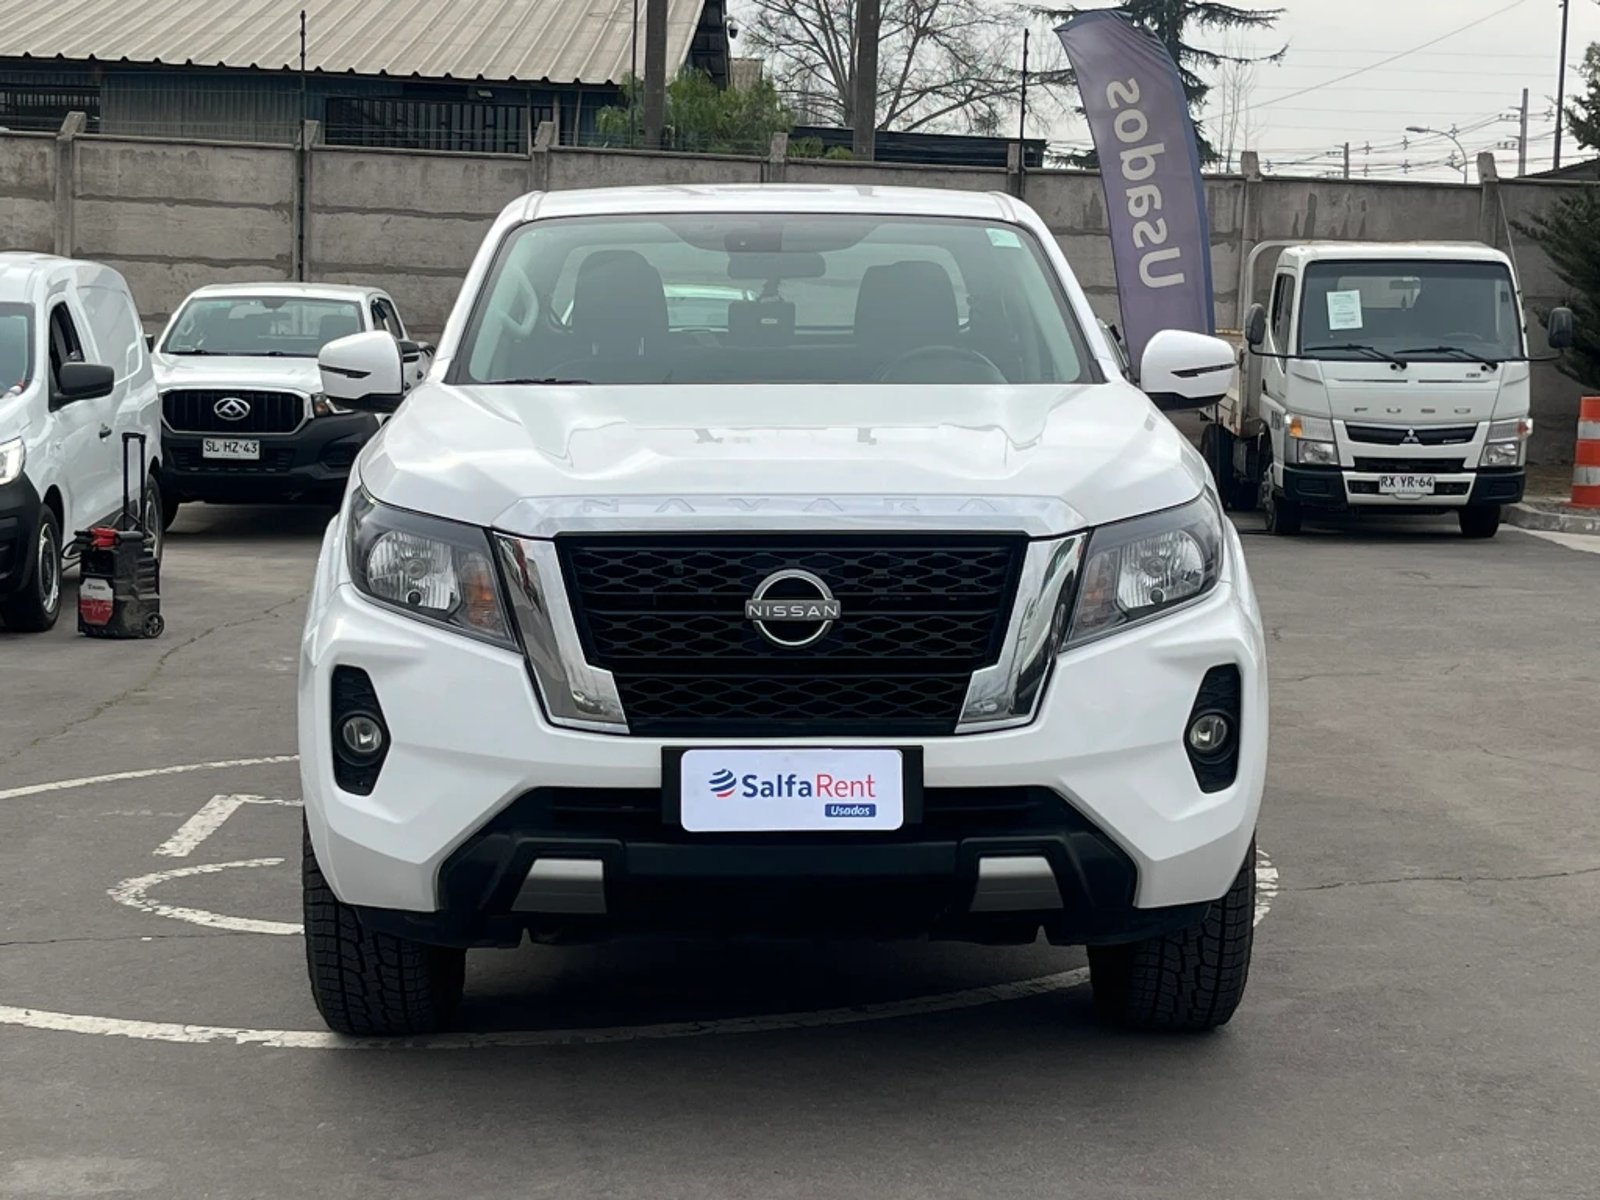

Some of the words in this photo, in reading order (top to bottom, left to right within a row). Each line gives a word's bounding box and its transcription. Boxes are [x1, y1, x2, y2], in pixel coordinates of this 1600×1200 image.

[582, 497, 1000, 513] NAVARA
[748, 605, 837, 617] NISSAN
[742, 773, 877, 799] SalfaRent
[830, 806, 870, 817] Usados
